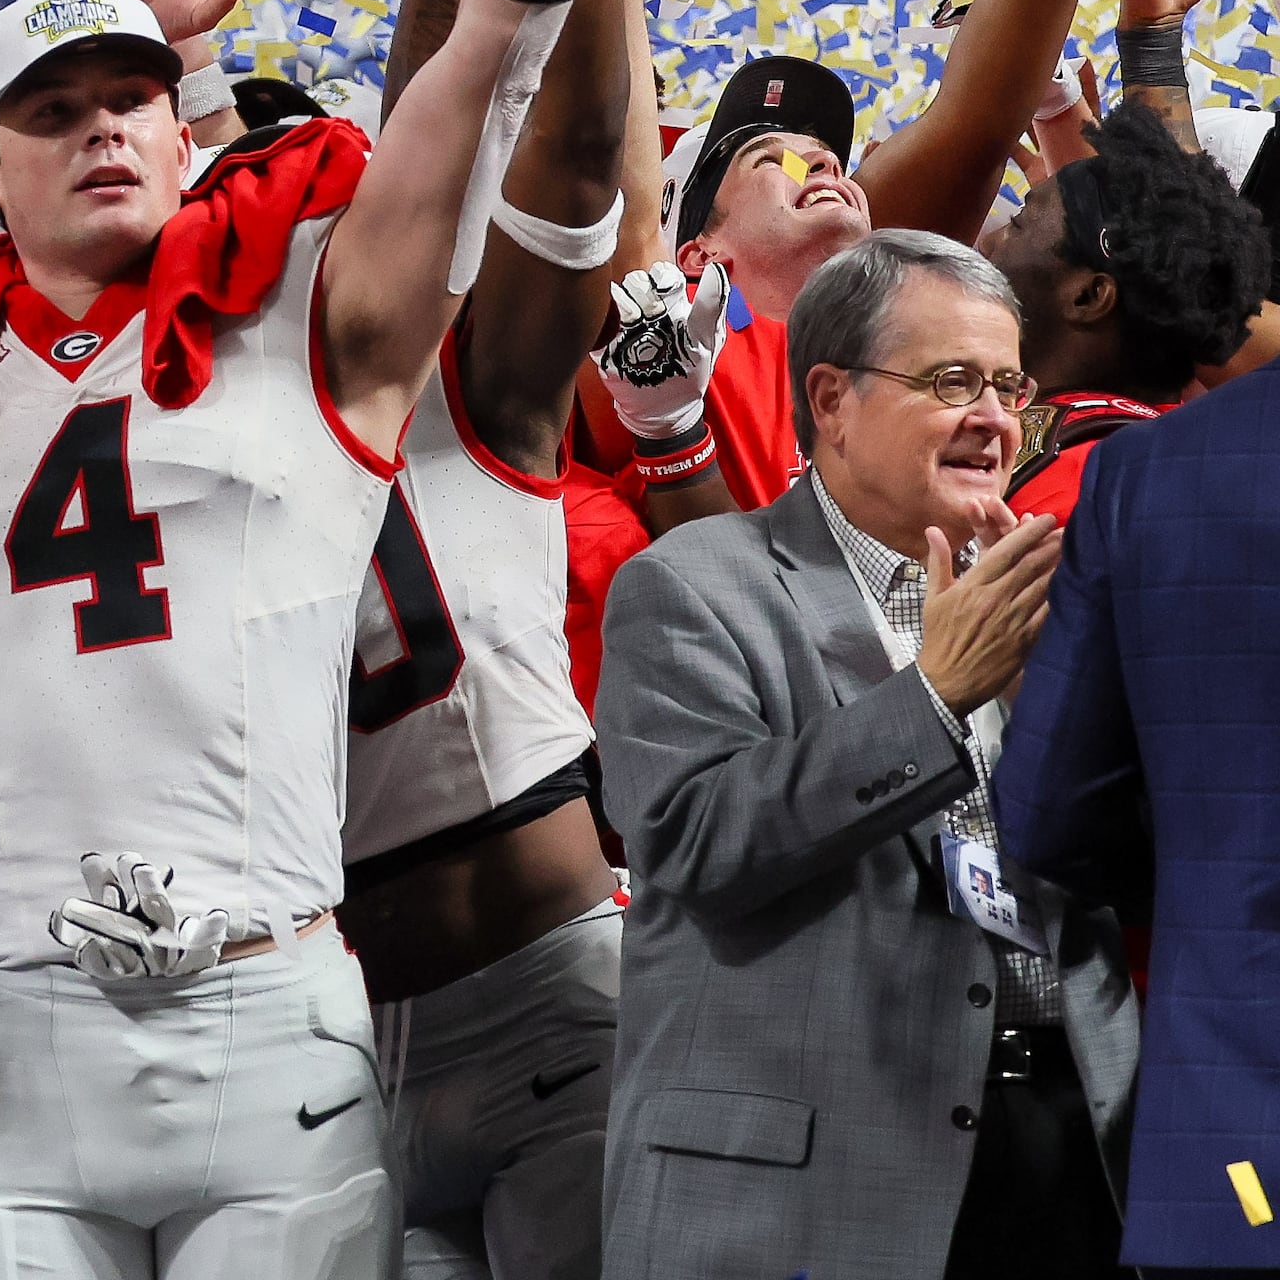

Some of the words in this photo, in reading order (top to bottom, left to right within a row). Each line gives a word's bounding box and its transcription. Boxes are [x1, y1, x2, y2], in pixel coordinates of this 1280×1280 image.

[26, 3, 119, 34] CHAMPIONS
[58, 335, 100, 359] G
[654, 458, 692, 476] THEM
[3, 395, 172, 655] 4
